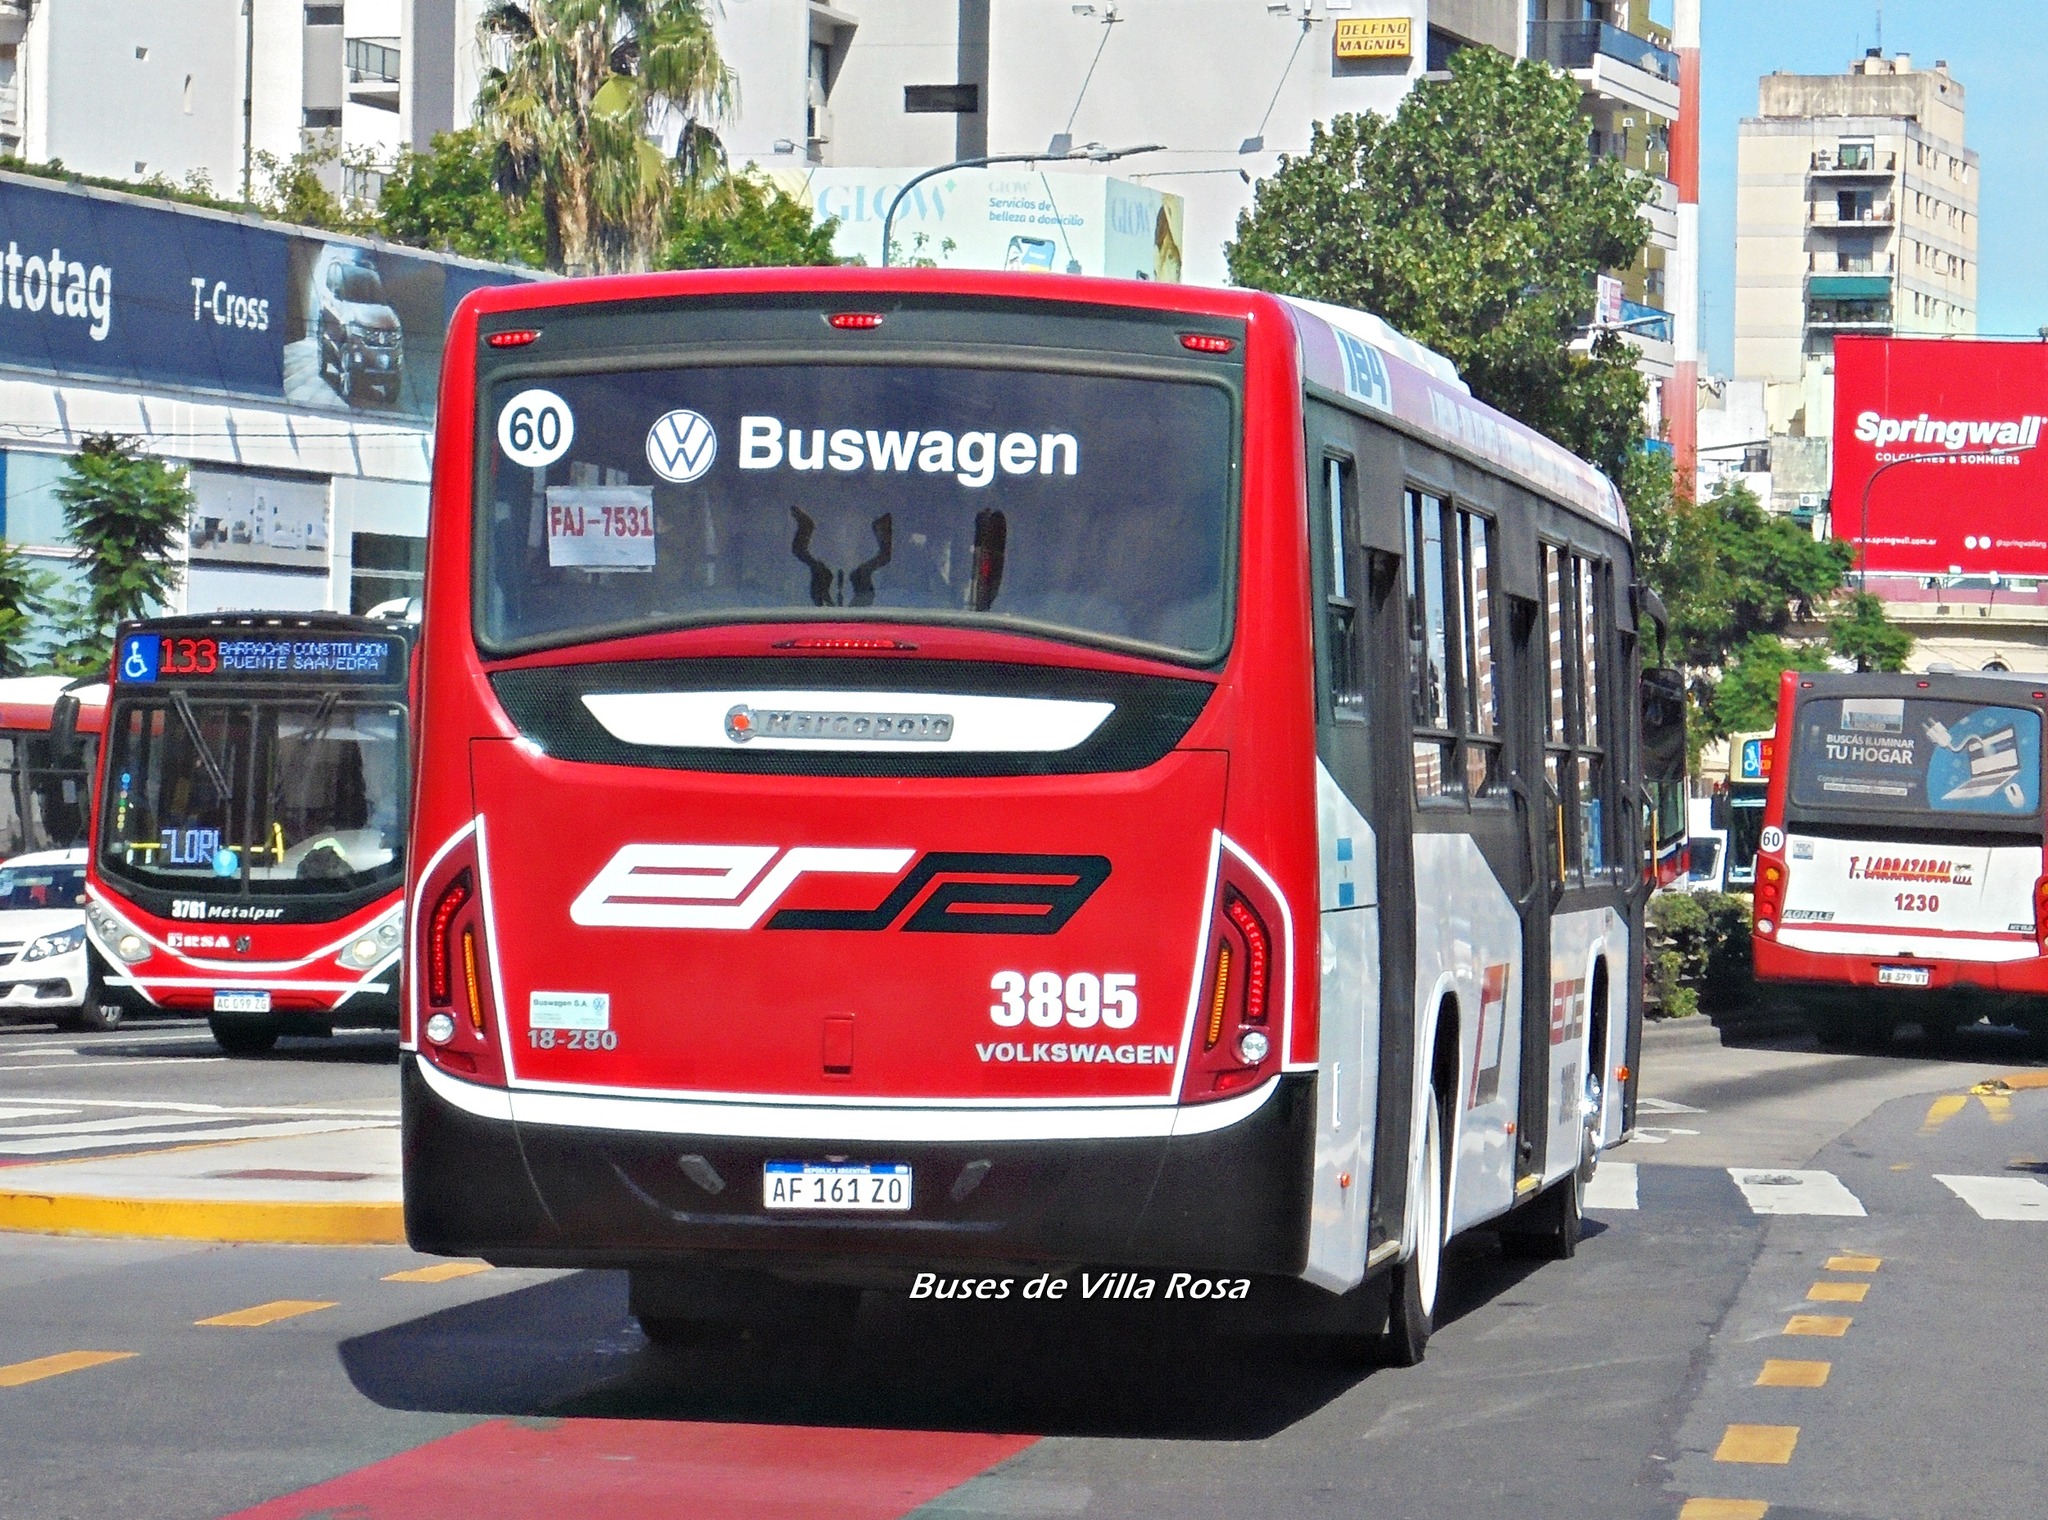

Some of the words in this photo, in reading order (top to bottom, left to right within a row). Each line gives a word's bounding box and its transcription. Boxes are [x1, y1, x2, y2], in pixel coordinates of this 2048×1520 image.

[1341, 23, 1408, 36] DELFINO
[1340, 39, 1406, 51] MAGNUS
[989, 197, 1036, 210] Servicios
[1038, 200, 1052, 211] de
[989, 211, 1027, 223] belleza
[1028, 214, 1036, 223] a
[0, 240, 112, 341] totag
[191, 277, 269, 331] T-Cross
[509, 406, 562, 452] 60
[1854, 411, 2042, 450] Springwall
[739, 415, 1078, 488] Buswagen
[1960, 455, 2020, 465] SOMMIERS
[550, 506, 654, 537] FAJ-7531
[160, 638, 219, 674] 133
[223, 656, 288, 669] PUENTE
[292, 656, 379, 671] SAAVEDRA
[1826, 733, 1864, 744] BUSCÁS
[1865, 737, 1915, 749] ILUMINAR
[1826, 745, 1848, 760] TU
[1851, 747, 1913, 764] HOGAR
[1762, 831, 1780, 847] 60
[171, 900, 205, 918] 3761
[208, 905, 283, 920] Metalpar
[1893, 893, 1940, 913] 1230
[989, 970, 1138, 1029] 3895
[528, 1029, 618, 1051] 18-280
[975, 1043, 1174, 1064] VOLKSWAGEN
[773, 1177, 803, 1202] AF
[813, 1178, 860, 1203] 161
